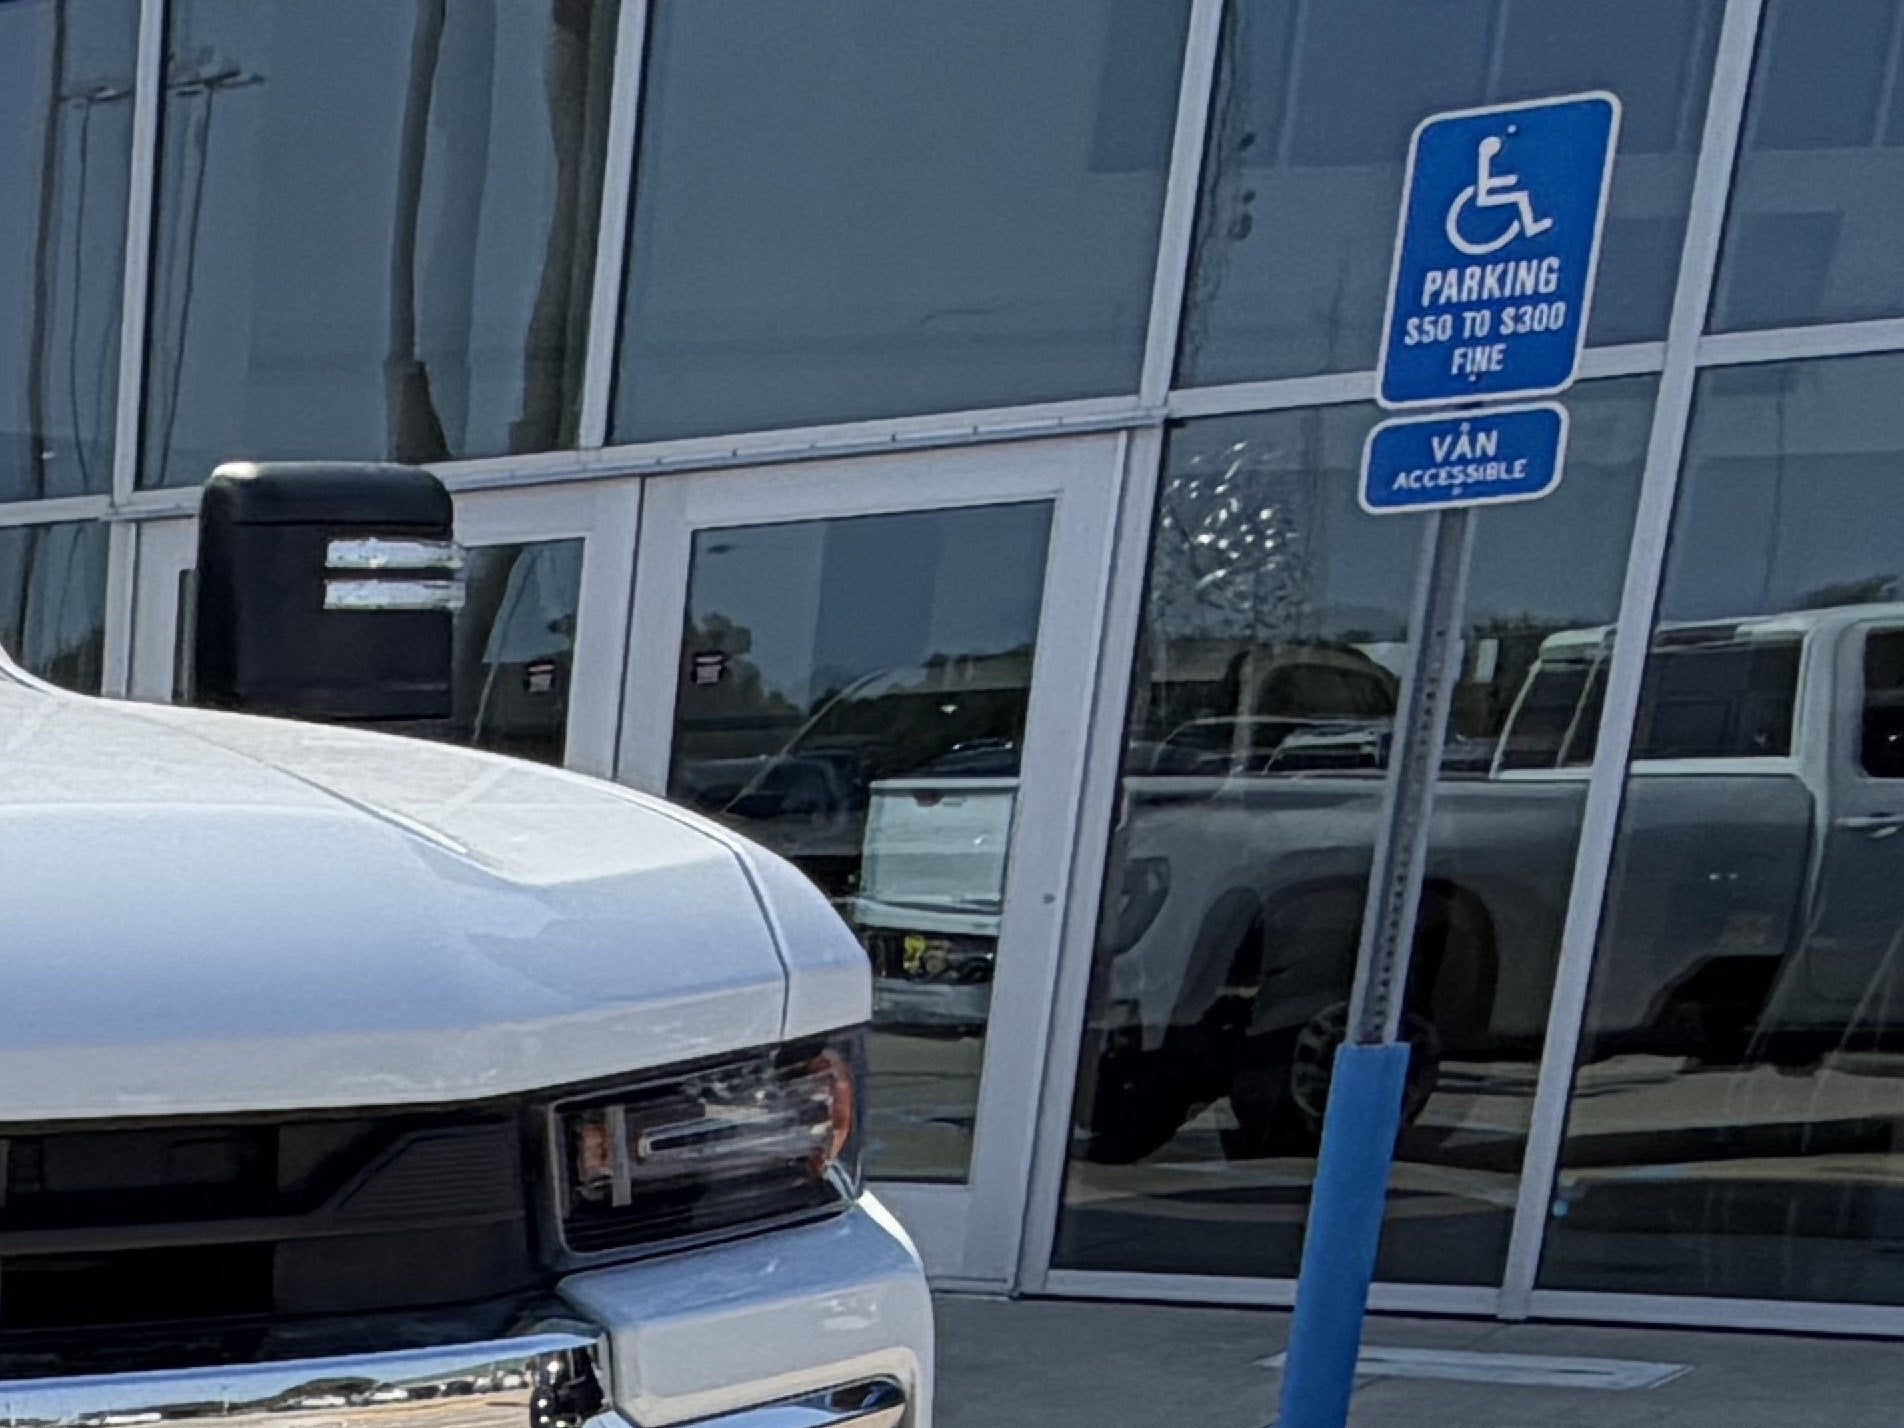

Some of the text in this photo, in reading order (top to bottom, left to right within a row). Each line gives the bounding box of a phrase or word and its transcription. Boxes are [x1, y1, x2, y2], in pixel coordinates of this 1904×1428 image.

[1422, 256, 1562, 308] PARKING
[1403, 300, 1567, 346] $50 TO $300
[1450, 343, 1508, 376] FINE
[1431, 429, 1498, 464] VAN
[1392, 457, 1529, 491] ACCESSIBLE
